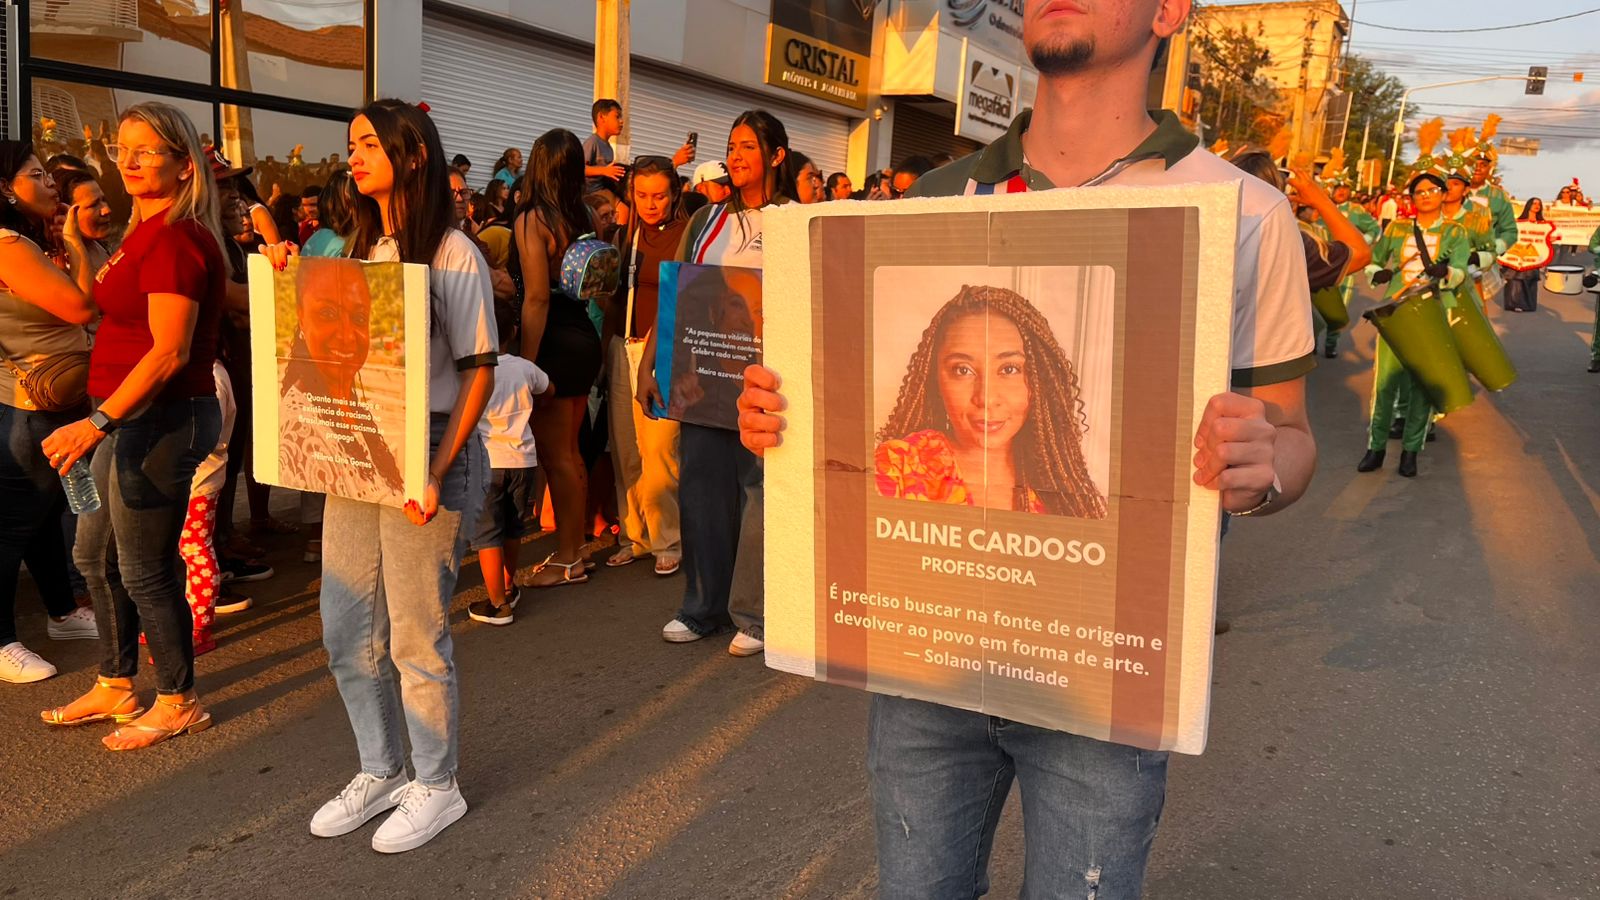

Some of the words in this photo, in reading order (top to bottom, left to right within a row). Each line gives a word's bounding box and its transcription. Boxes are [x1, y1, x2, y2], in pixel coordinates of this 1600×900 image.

[784, 38, 859, 87] CRISTAL
[683, 336, 693, 344] dia
[699, 338, 709, 347] dia
[710, 340, 736, 351] também
[697, 330, 727, 339] pequenas
[728, 332, 752, 342] vitórias
[753, 335, 762, 344] do
[691, 346, 715, 357] Celebre
[716, 350, 731, 359] cada
[718, 371, 744, 381] azevedo
[332, 396, 348, 405] mais
[357, 401, 374, 410] nega
[302, 406, 335, 415] existência
[336, 407, 345, 417] do
[345, 410, 372, 421] racismo
[335, 421, 350, 430] esse
[350, 423, 377, 434] racismo
[350, 457, 372, 469] Gomes
[876, 517, 962, 548] DALINE
[968, 528, 1106, 566] CARDOSO
[921, 556, 1037, 587] PROFESSORA
[829, 583, 839, 600] É
[842, 589, 900, 609] preciso
[904, 596, 962, 619] buscar
[966, 608, 988, 624] na
[993, 610, 1043, 632] fonte
[1047, 619, 1071, 637] de
[1076, 626, 1145, 648] origem
[1150, 637, 1163, 651] e
[834, 610, 903, 633] devolver
[907, 624, 928, 638] ao
[932, 627, 975, 645] povo
[979, 636, 1007, 652] em
[1011, 639, 1069, 662] forma
[1074, 649, 1098, 667] de
[1102, 656, 1150, 676] arte.
[924, 649, 982, 673] Solano
[987, 659, 1069, 688] Trindade
